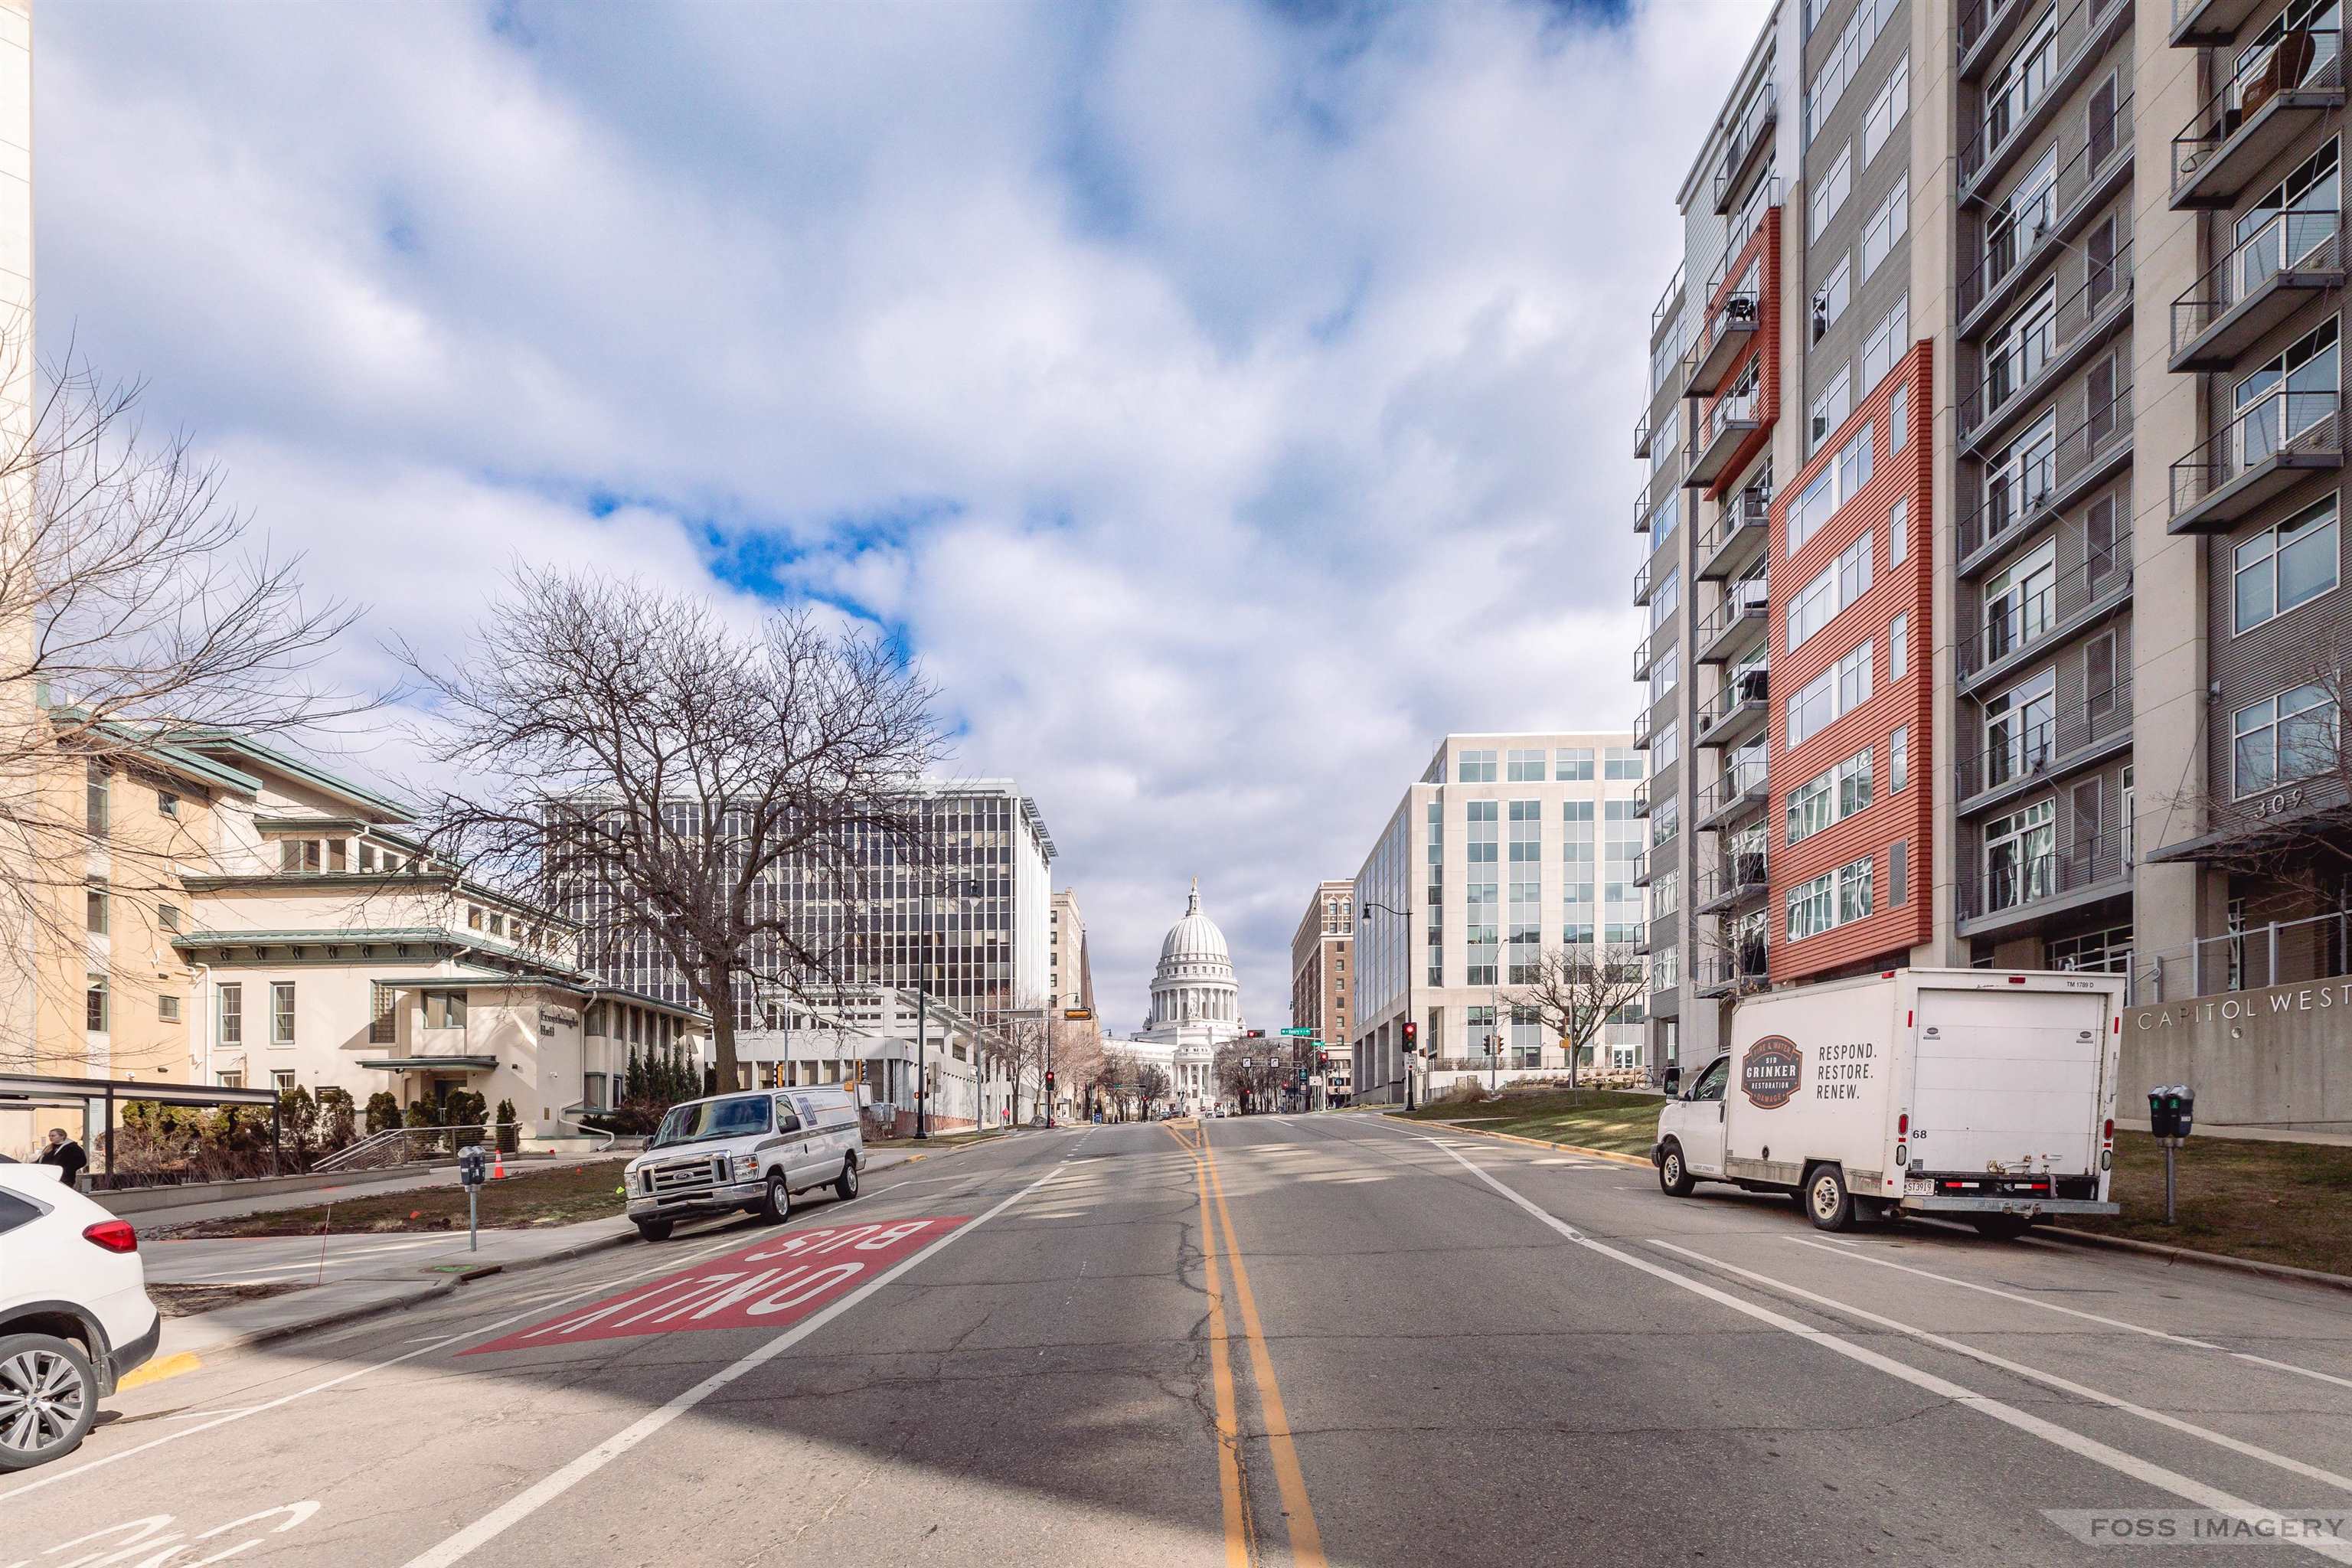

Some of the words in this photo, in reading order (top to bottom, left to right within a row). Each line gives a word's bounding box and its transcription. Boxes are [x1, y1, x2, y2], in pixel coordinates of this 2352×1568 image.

[2252, 787, 2304, 820] 309
[2138, 998, 2257, 1030] CAPITOL
[2269, 983, 2352, 1014] WEST
[1818, 1043, 1877, 1061] RESPOND.
[1746, 1065, 1796, 1078] GRINKER
[1818, 1063, 1873, 1080] RESTORE.
[1751, 1081, 1789, 1089] RESTORATION
[1817, 1084, 1860, 1099] RENEW.
[1756, 1093, 1782, 1103] DAMAGE
[1913, 1129, 1927, 1139] 68
[744, 1220, 936, 1263] BUS
[520, 1262, 865, 1340] ONLY
